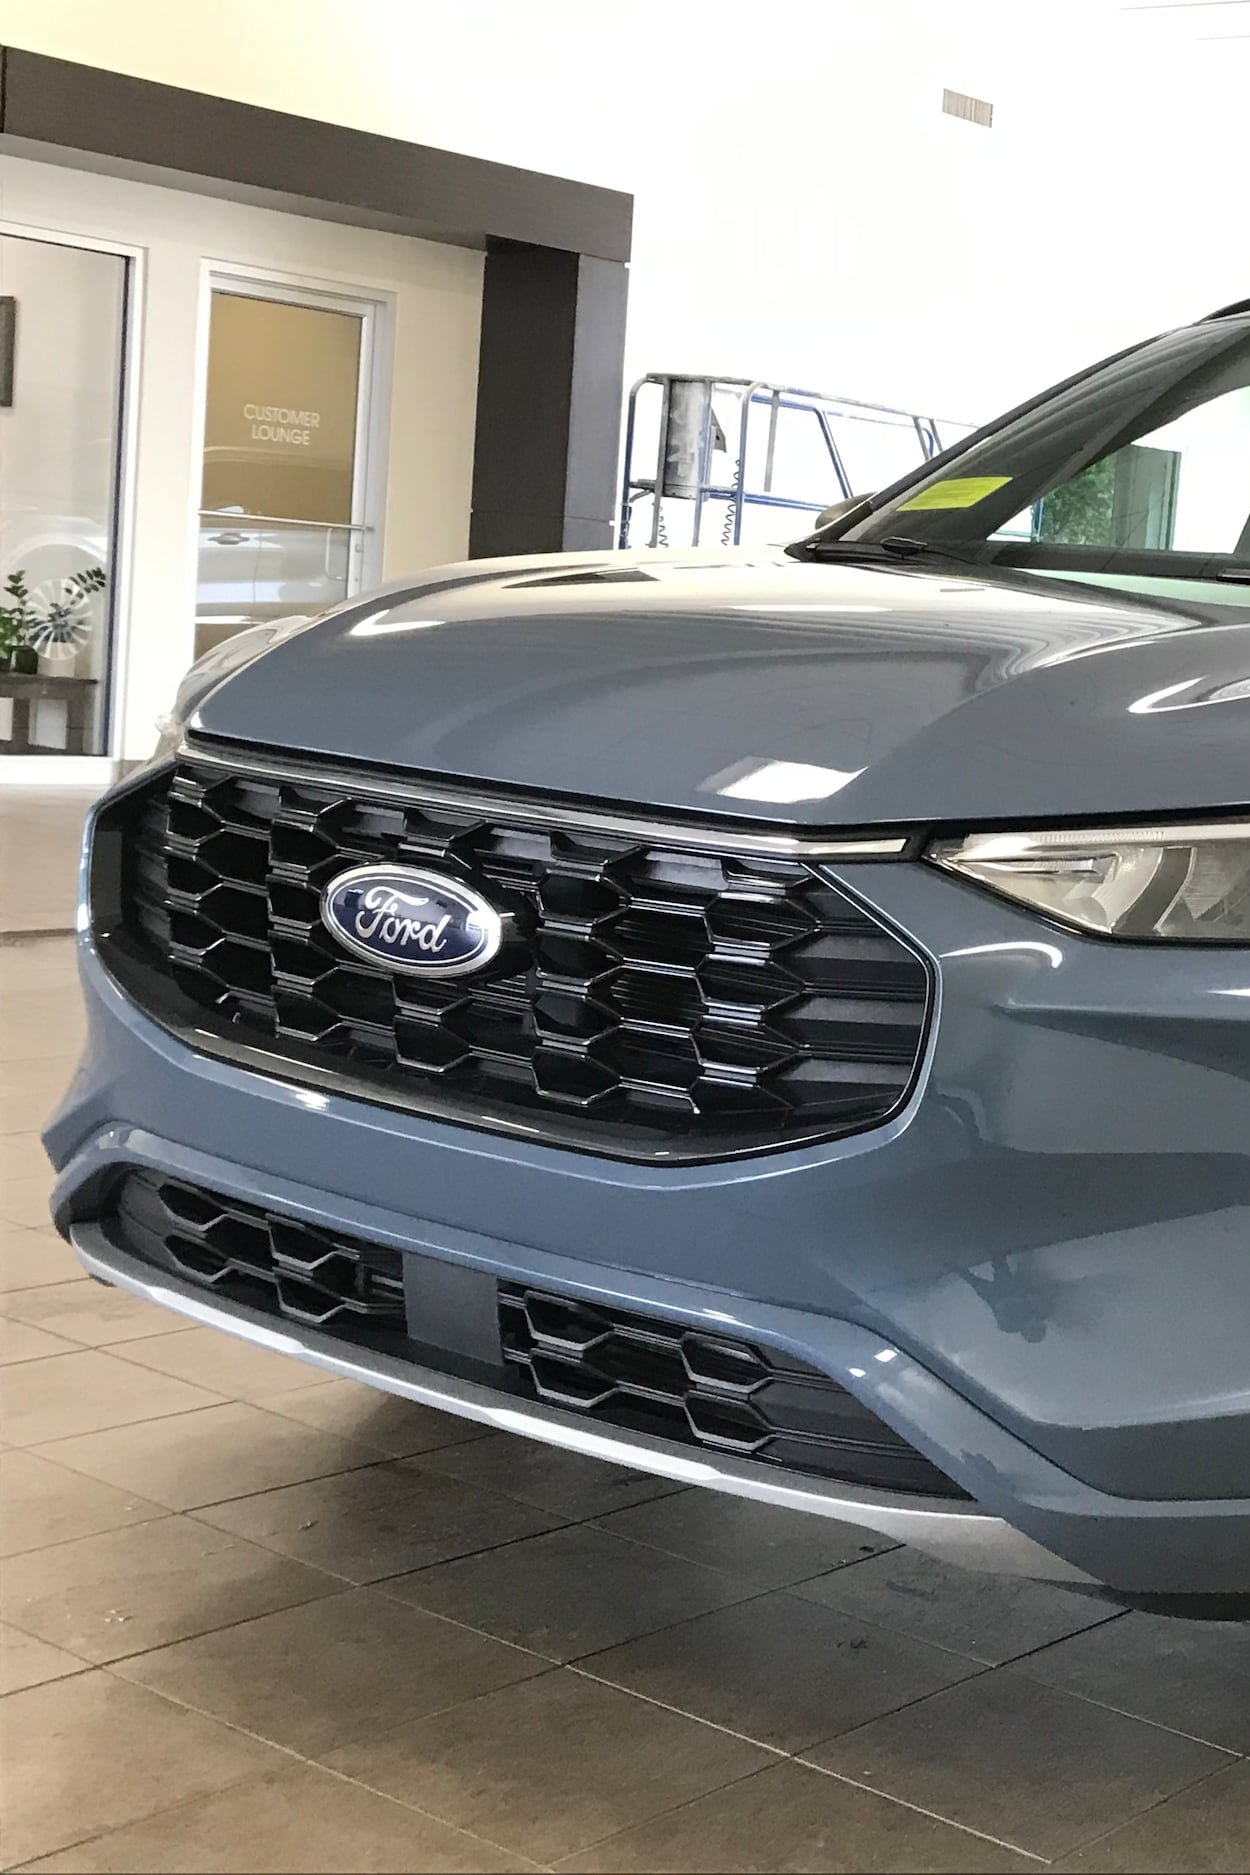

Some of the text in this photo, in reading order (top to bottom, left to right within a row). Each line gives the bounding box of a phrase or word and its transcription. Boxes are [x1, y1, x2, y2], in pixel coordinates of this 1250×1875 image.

[243, 403, 320, 429] CUSTOMER
[251, 423, 311, 446] LOUNGE
[354, 885, 452, 953] Ford
